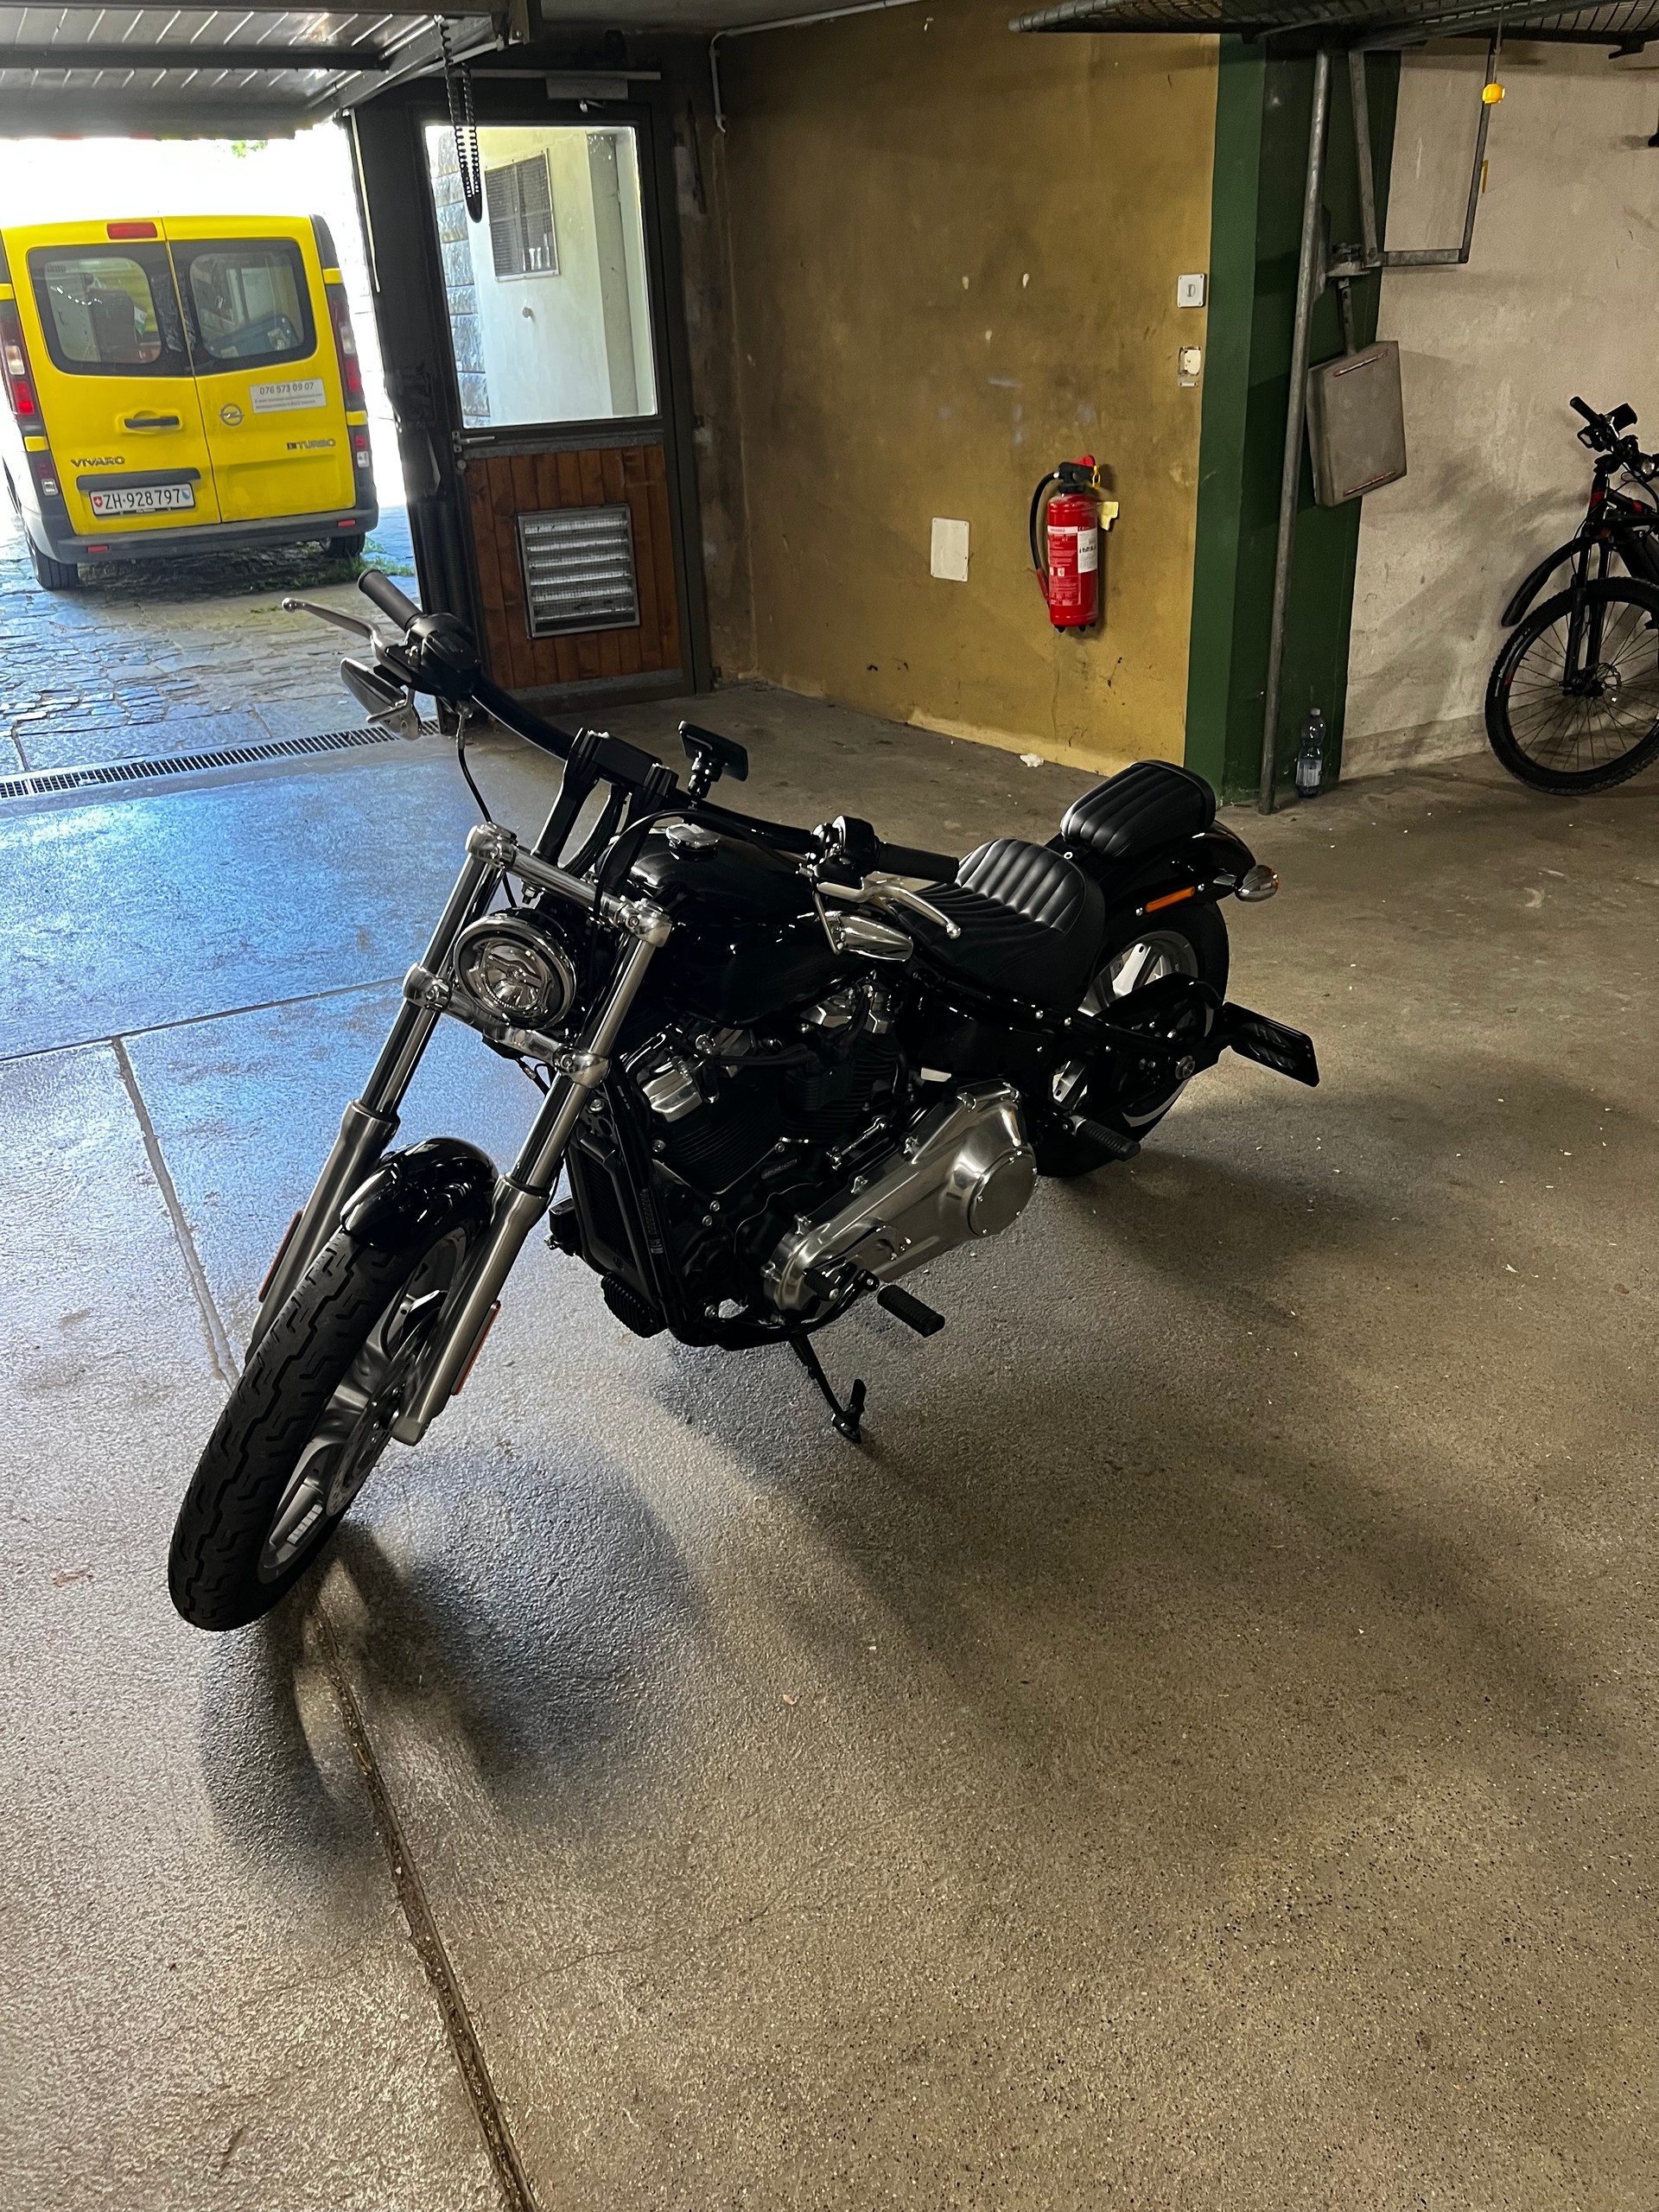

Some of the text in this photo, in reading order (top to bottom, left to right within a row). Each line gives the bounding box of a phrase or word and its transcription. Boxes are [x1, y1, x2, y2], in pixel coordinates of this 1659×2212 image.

[259, 381, 315, 395] 076 573 09 07
[70, 456, 125, 467] VIVARO
